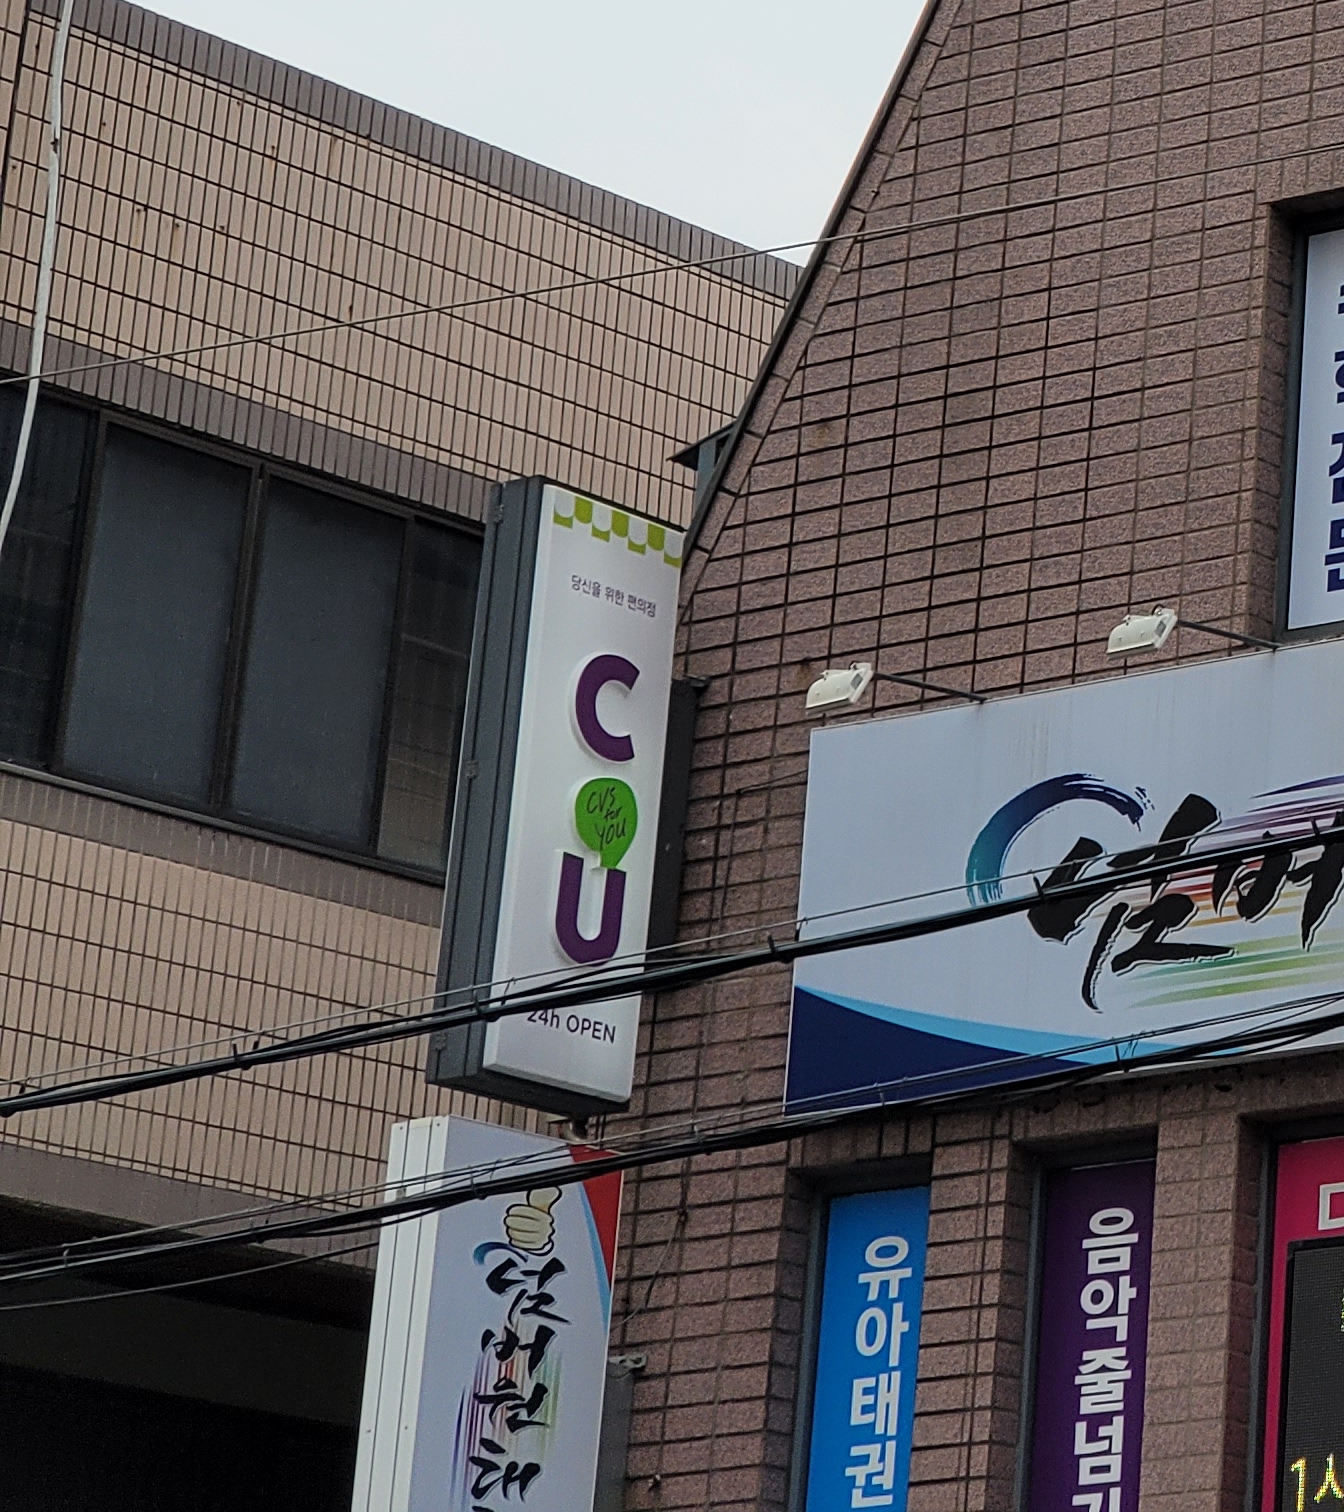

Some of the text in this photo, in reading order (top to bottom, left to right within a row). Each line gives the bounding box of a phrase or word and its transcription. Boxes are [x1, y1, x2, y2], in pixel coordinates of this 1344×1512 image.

[571, 574, 602, 598] 당신을
[604, 586, 625, 606] 위한
[586, 786, 616, 814] CVS
[566, 1014, 616, 1044] OPEN
